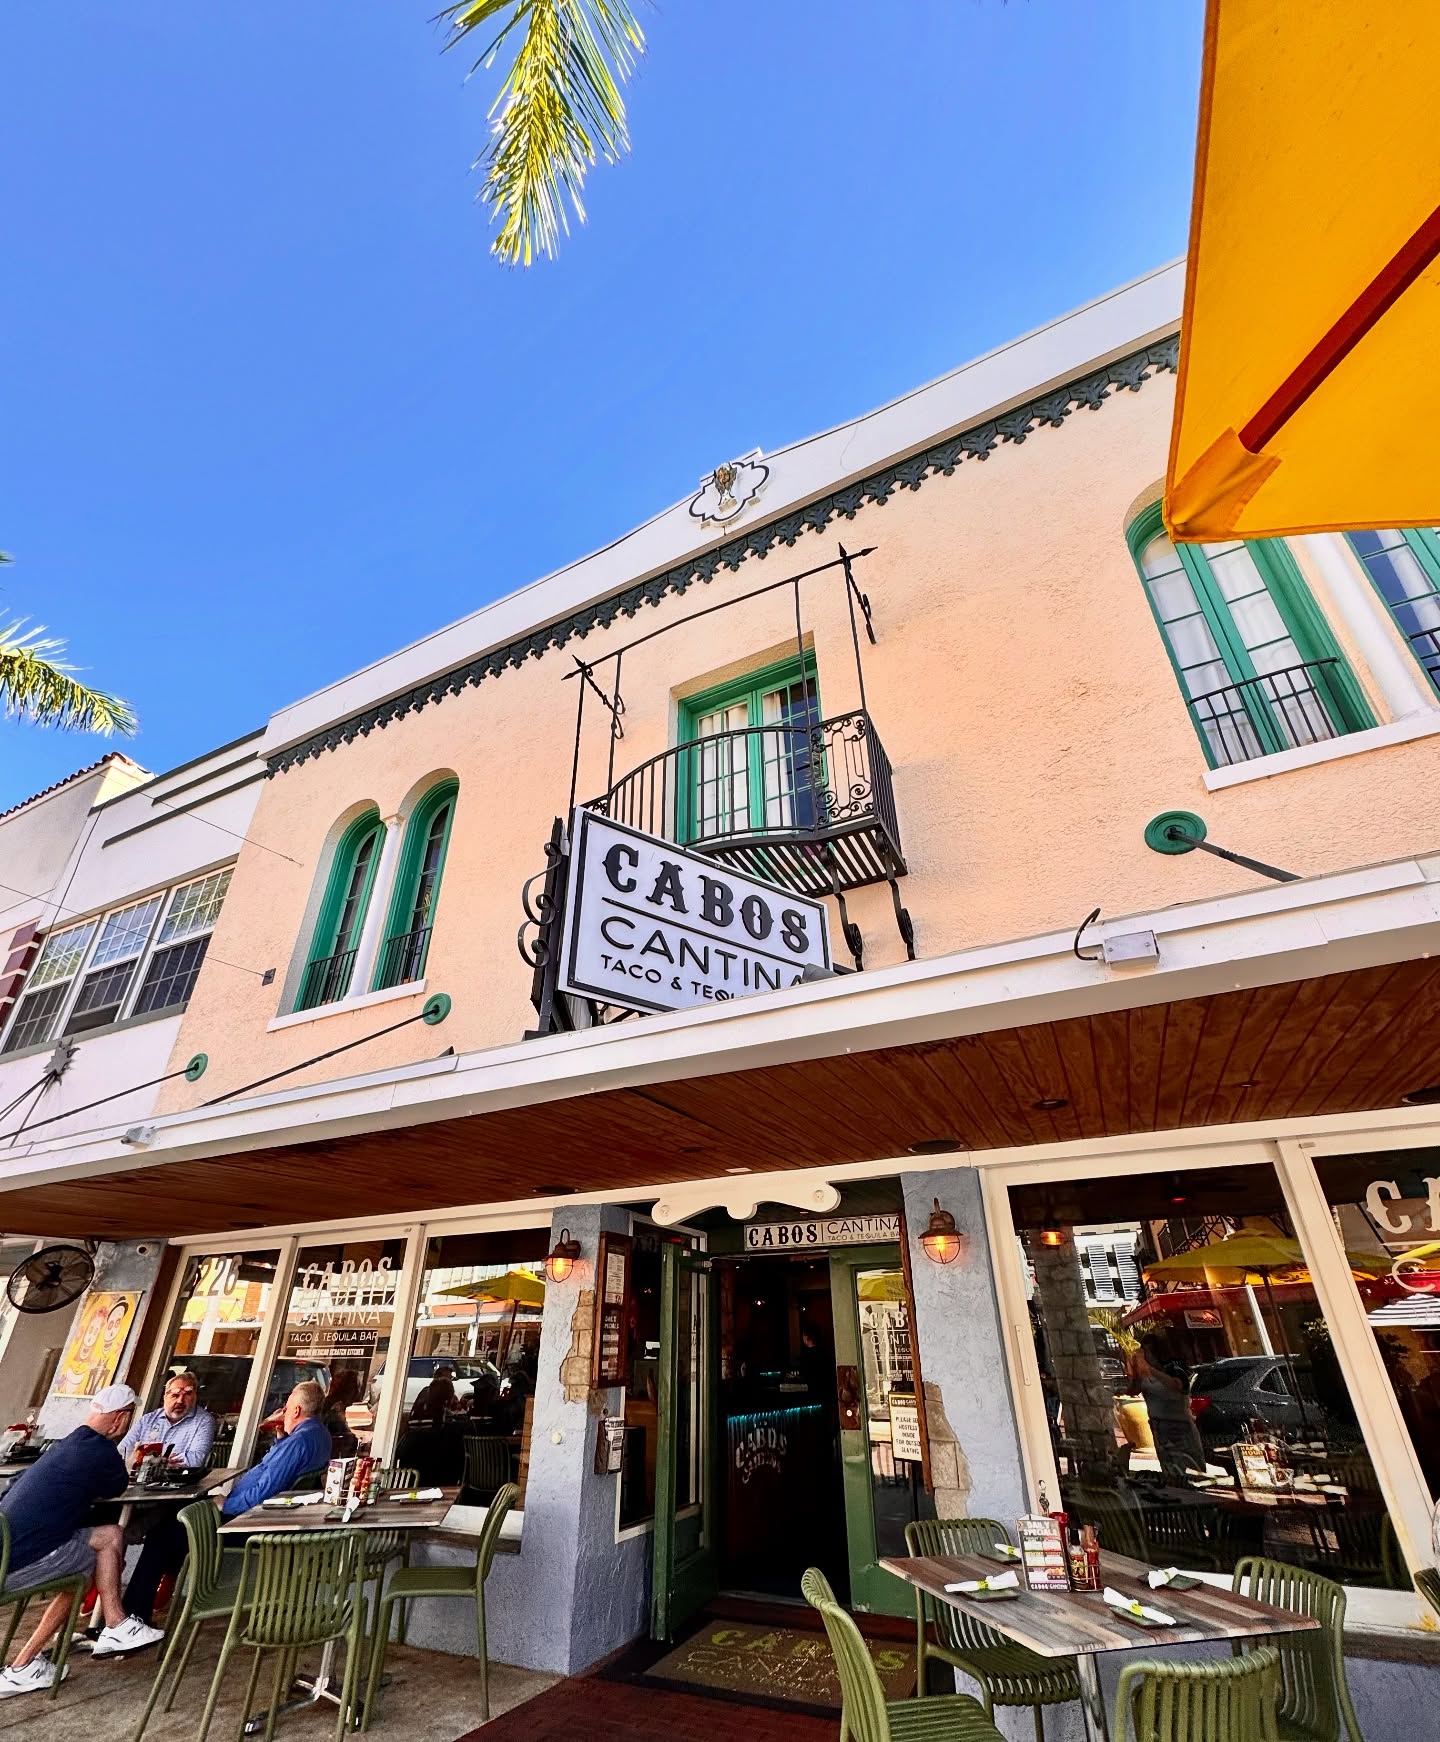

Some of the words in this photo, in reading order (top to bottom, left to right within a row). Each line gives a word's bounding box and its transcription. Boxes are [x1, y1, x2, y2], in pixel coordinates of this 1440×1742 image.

[602, 843, 809, 954] CABOS
[601, 954, 662, 984] TACO
[671, 976, 683, 991] &
[691, 981, 735, 1001] TEQ
[749, 1224, 818, 1247] CABOS
[827, 1216, 900, 1234] CANTINA
[857, 1231, 888, 1240] TEQUILA
[890, 1230, 900, 1238] BA
[180, 1255, 243, 1298] 2226
[302, 1256, 393, 1292] CABOS
[295, 1303, 381, 1327] CANTINA
[869, 1311, 909, 1329] CAB
[290, 1333, 312, 1342] TACO
[314, 1333, 320, 1342] &
[323, 1331, 357, 1342] TEQUILA
[359, 1331, 379, 1341] BAR
[1023, 1528, 1058, 1536] SPECIALS
[1026, 1521, 1050, 1529] DAILY
[711, 1629, 910, 1671] CABS
